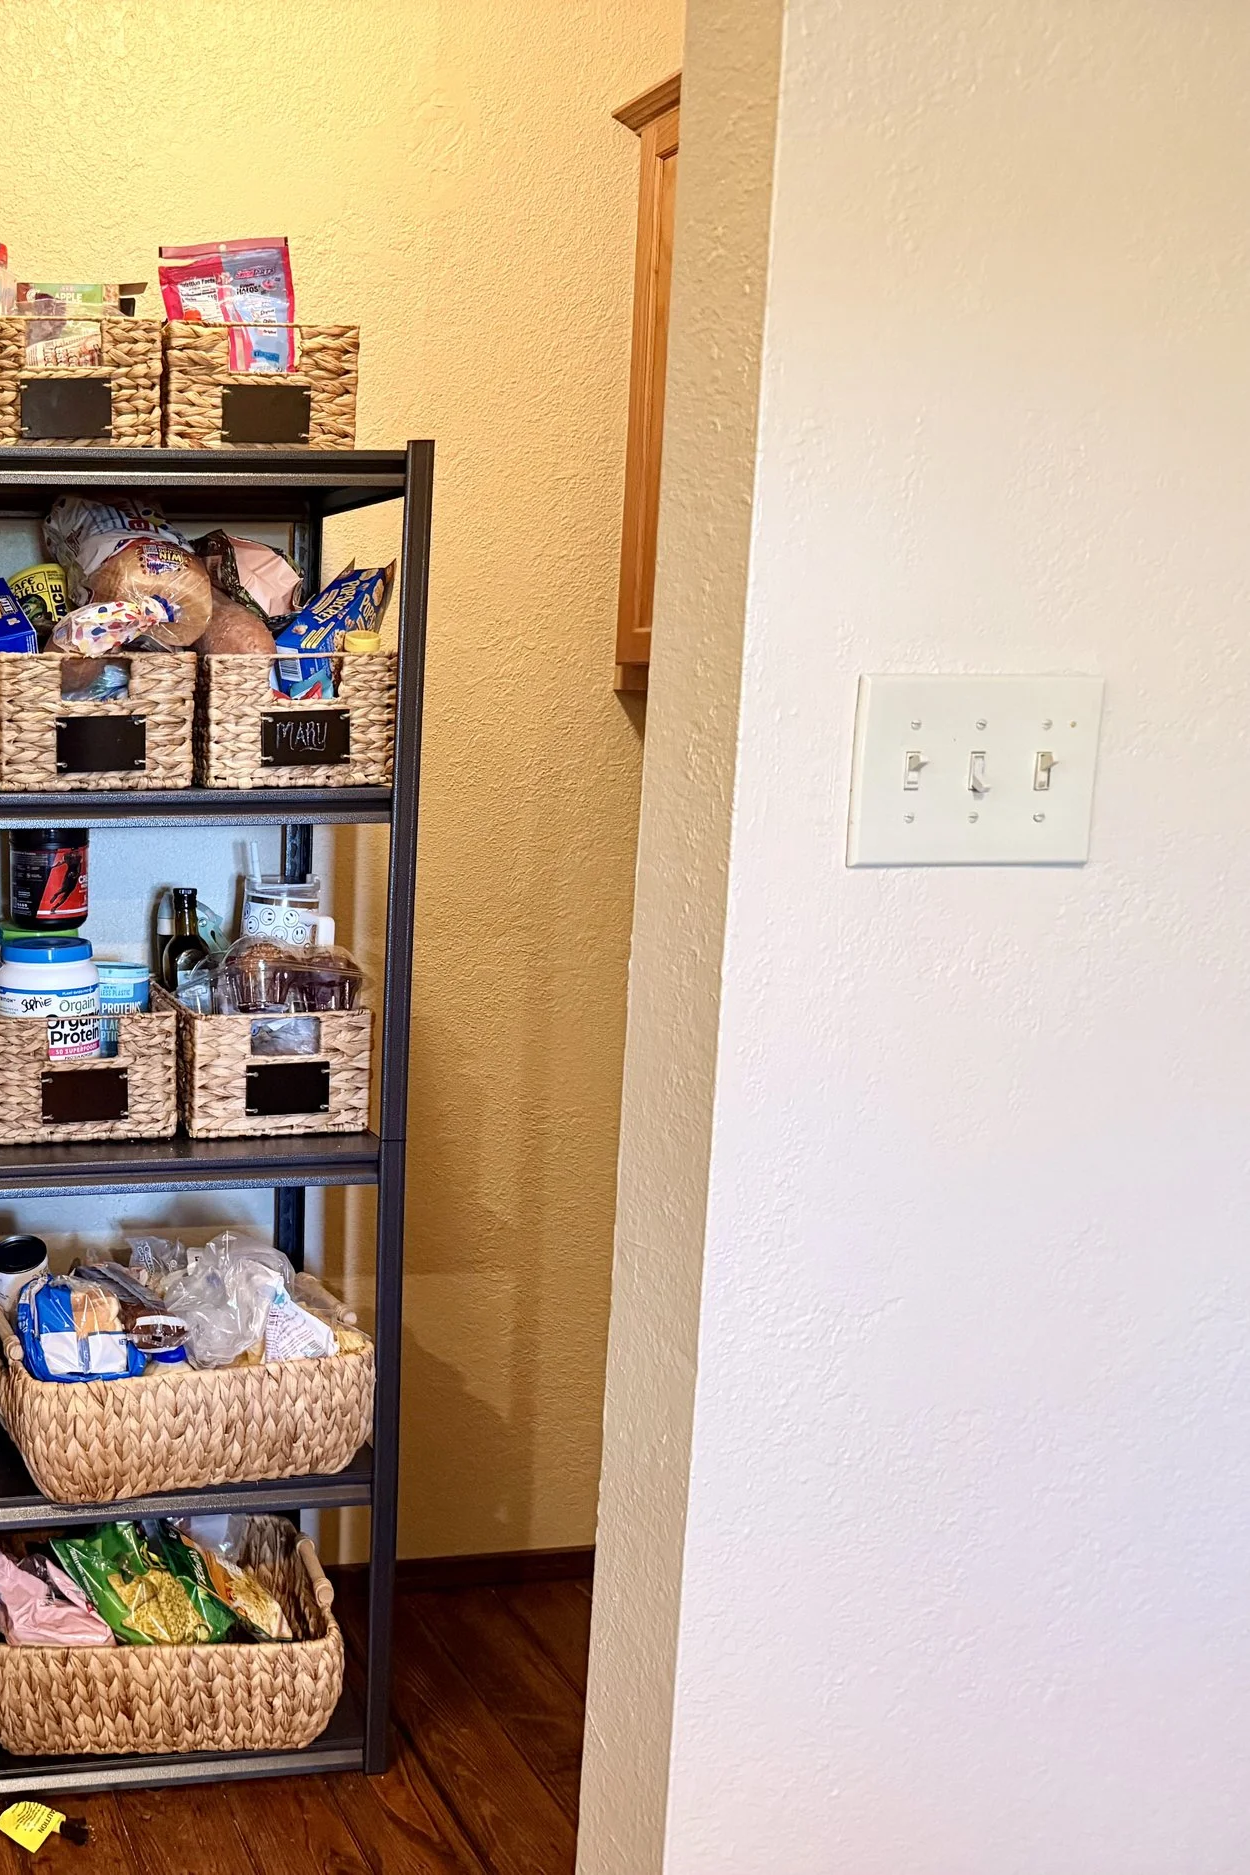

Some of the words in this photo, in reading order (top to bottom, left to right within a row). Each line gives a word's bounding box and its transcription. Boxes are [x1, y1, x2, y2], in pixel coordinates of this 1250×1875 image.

[54, 293, 83, 302] APPLE
[50, 584, 68, 616] ACE
[276, 721, 328, 752] MARY
[59, 996, 95, 1014] Orgain
[50, 1025, 99, 1045] Protein
[37, 1809, 56, 1834] AUTION
